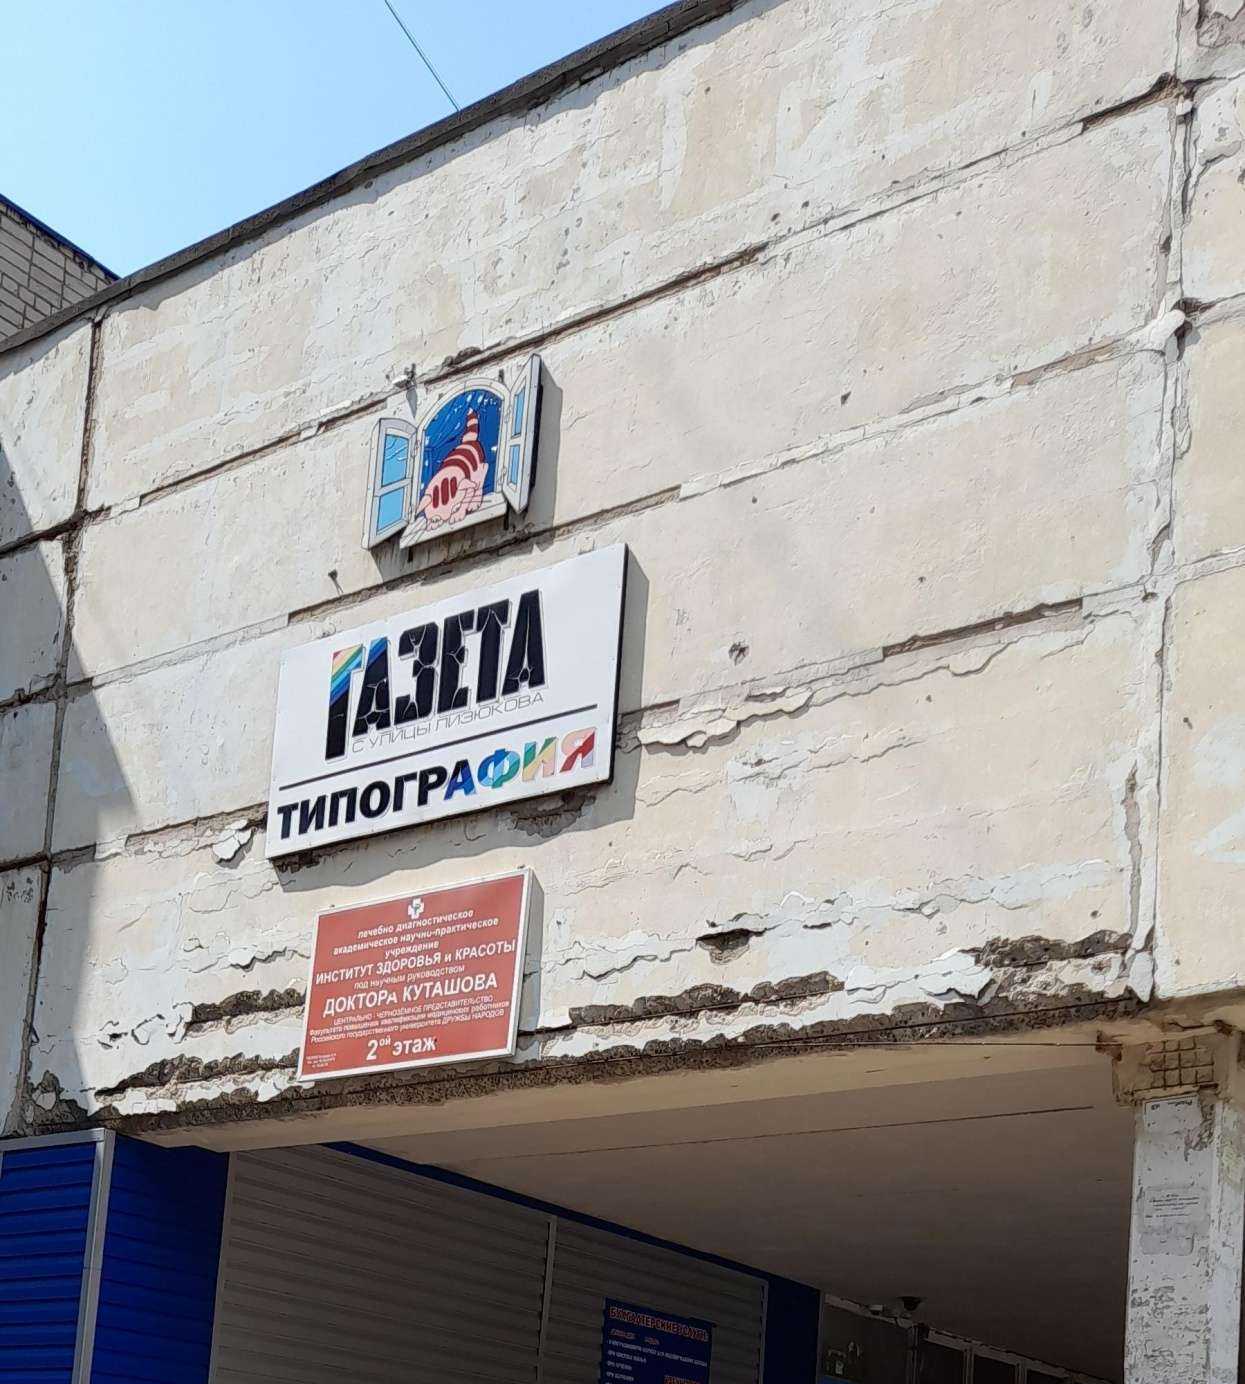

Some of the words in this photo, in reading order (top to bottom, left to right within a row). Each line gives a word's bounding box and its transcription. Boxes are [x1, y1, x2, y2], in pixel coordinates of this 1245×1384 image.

[325, 588, 547, 761] ГАЗЕТА
[352, 737, 365, 753] С
[369, 724, 432, 747] УЛИЦЫ
[435, 692, 545, 729] ЛИЗЮКОВА
[277, 726, 598, 840] ТИПОГРАФИЯ
[333, 936, 398, 955] академическое
[400, 918, 499, 943] научно-практическое
[358, 924, 394, 939] лечебно
[395, 910, 474, 932] диагностическое
[316, 964, 374, 985] ИНСТИТУТ
[376, 951, 442, 975] ЗДОРОВЬЯ
[444, 952, 452, 962] и
[455, 939, 516, 961] КРАСОТЫ
[385, 941, 439, 959] учреждение
[353, 980, 369, 990] под
[370, 974, 405, 988] научным
[407, 964, 465, 982] руководством
[402, 972, 498, 1002] КУТАШОВА
[392, 1036, 436, 1056] этаж
